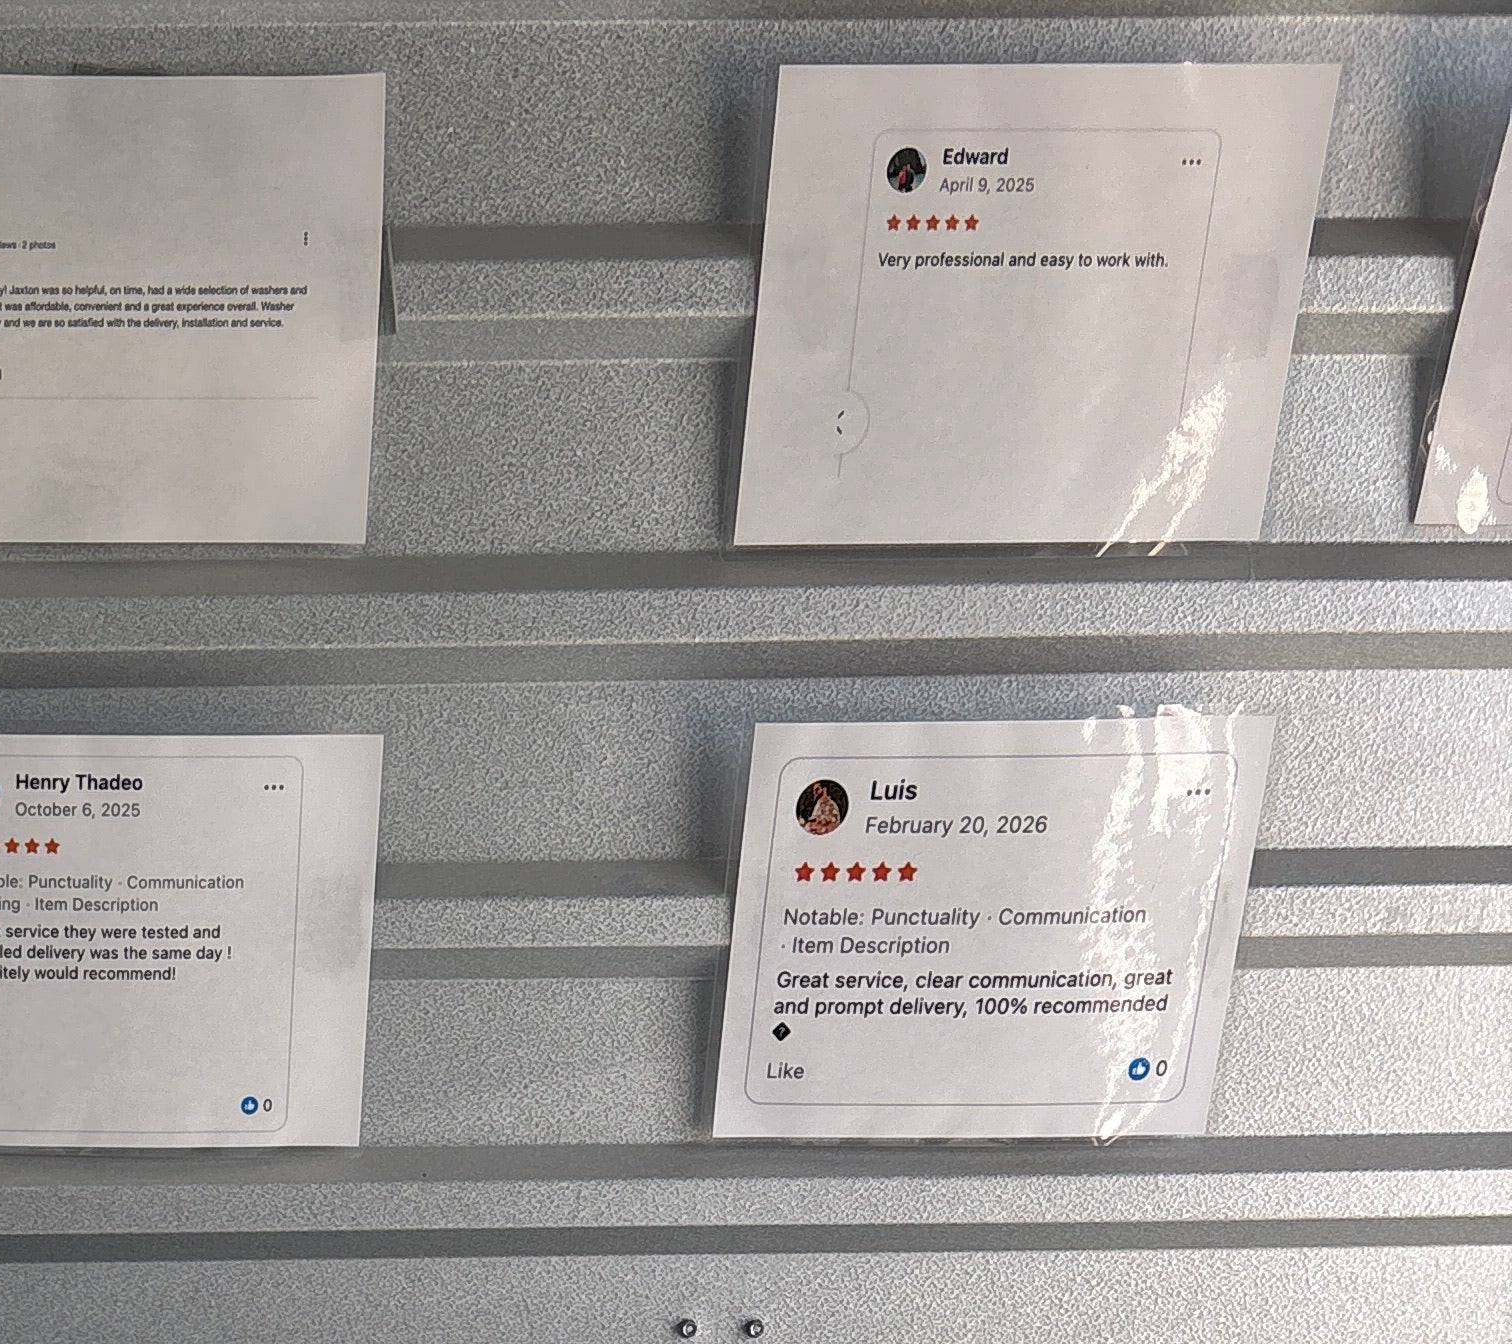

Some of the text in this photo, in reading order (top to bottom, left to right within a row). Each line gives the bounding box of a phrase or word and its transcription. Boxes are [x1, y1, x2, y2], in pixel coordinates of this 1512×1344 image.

[942, 147, 1009, 165] Edward
[939, 176, 1035, 196] April 9, 2025
[878, 251, 1169, 271] Very professional and easy to work with.
[9, 284, 40, 296] Jaxton
[41, 286, 60, 296] was
[61, 286, 74, 296] so
[74, 284, 108, 298] helpful,
[109, 286, 122, 296] on
[123, 285, 146, 297] time,
[147, 285, 165, 296] had
[166, 286, 173, 296] a
[174, 285, 197, 296] wide
[197, 285, 239, 296] selection
[239, 284, 250, 296] of
[250, 285, 289, 296] washers
[289, 285, 308, 296] and
[15, 773, 143, 794] Henry Thadeo
[870, 778, 918, 801] Luis
[15, 801, 141, 820] October 6, 2025
[865, 815, 1048, 839] February 20, 2026
[28, 874, 113, 893] Punctuality
[126, 874, 245, 890] Communication
[35, 897, 68, 911] Item
[72, 896, 159, 915] Description
[783, 905, 1147, 930] Notable: Punctuality Communication
[5, 923, 60, 939] service
[63, 924, 97, 942] they
[100, 927, 137, 940] were
[141, 924, 189, 940] tested
[192, 924, 221, 939] and
[26, 944, 86, 963] delivery
[89, 948, 119, 960] was
[123, 945, 148, 960] the
[151, 948, 192, 960] same
[195, 945, 223, 963] day
[791, 935, 950, 958] Item Description
[34, 965, 79, 980] would
[83, 966, 176, 981] recommend!
[776, 968, 1174, 993] Great service, clear communication, great
[773, 993, 1169, 1019] and prompt delivery, 100% recommended
[766, 1061, 805, 1080] Like
